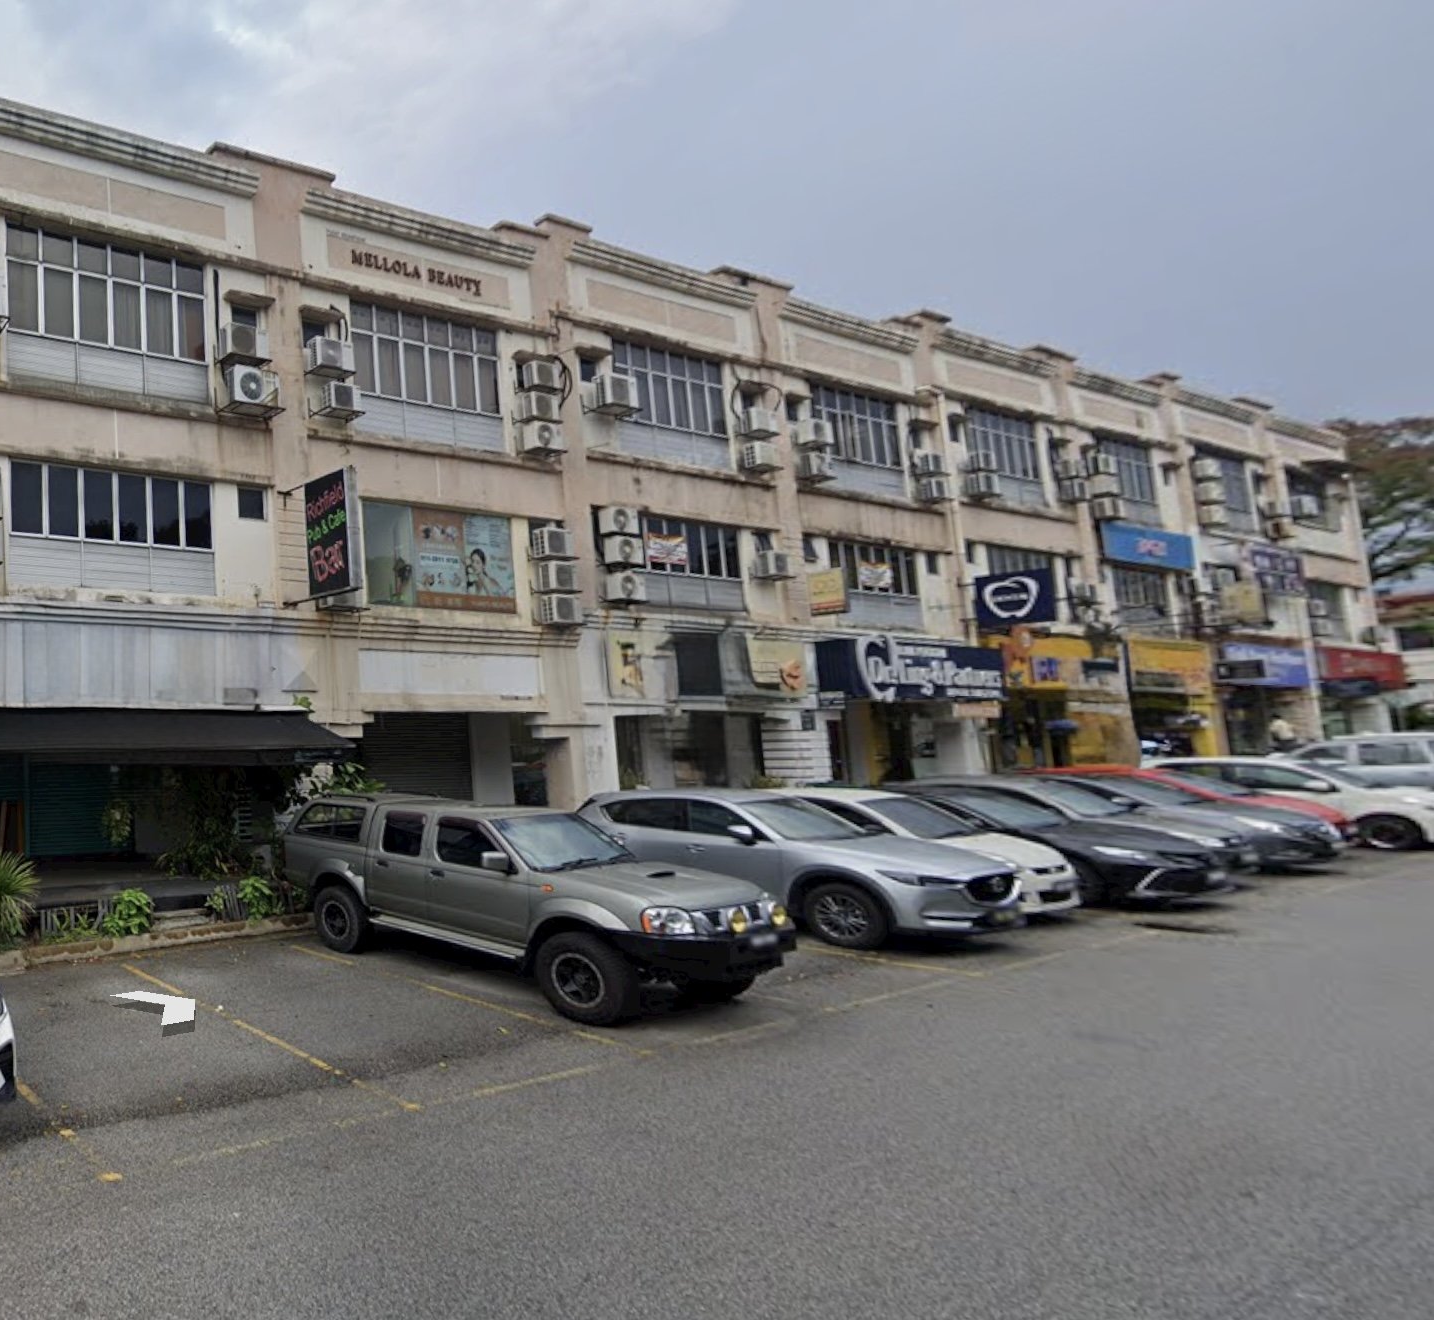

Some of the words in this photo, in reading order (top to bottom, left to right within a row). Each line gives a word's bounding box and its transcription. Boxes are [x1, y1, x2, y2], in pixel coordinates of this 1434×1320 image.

[351, 249, 421, 280] MELLOLA
[427, 267, 482, 297] BEAUTY
[307, 482, 344, 519] Richfield
[307, 524, 322, 544] Pub
[328, 508, 347, 530] Cafe
[309, 539, 346, 583] Bar
[943, 660, 1003, 687] Partners
